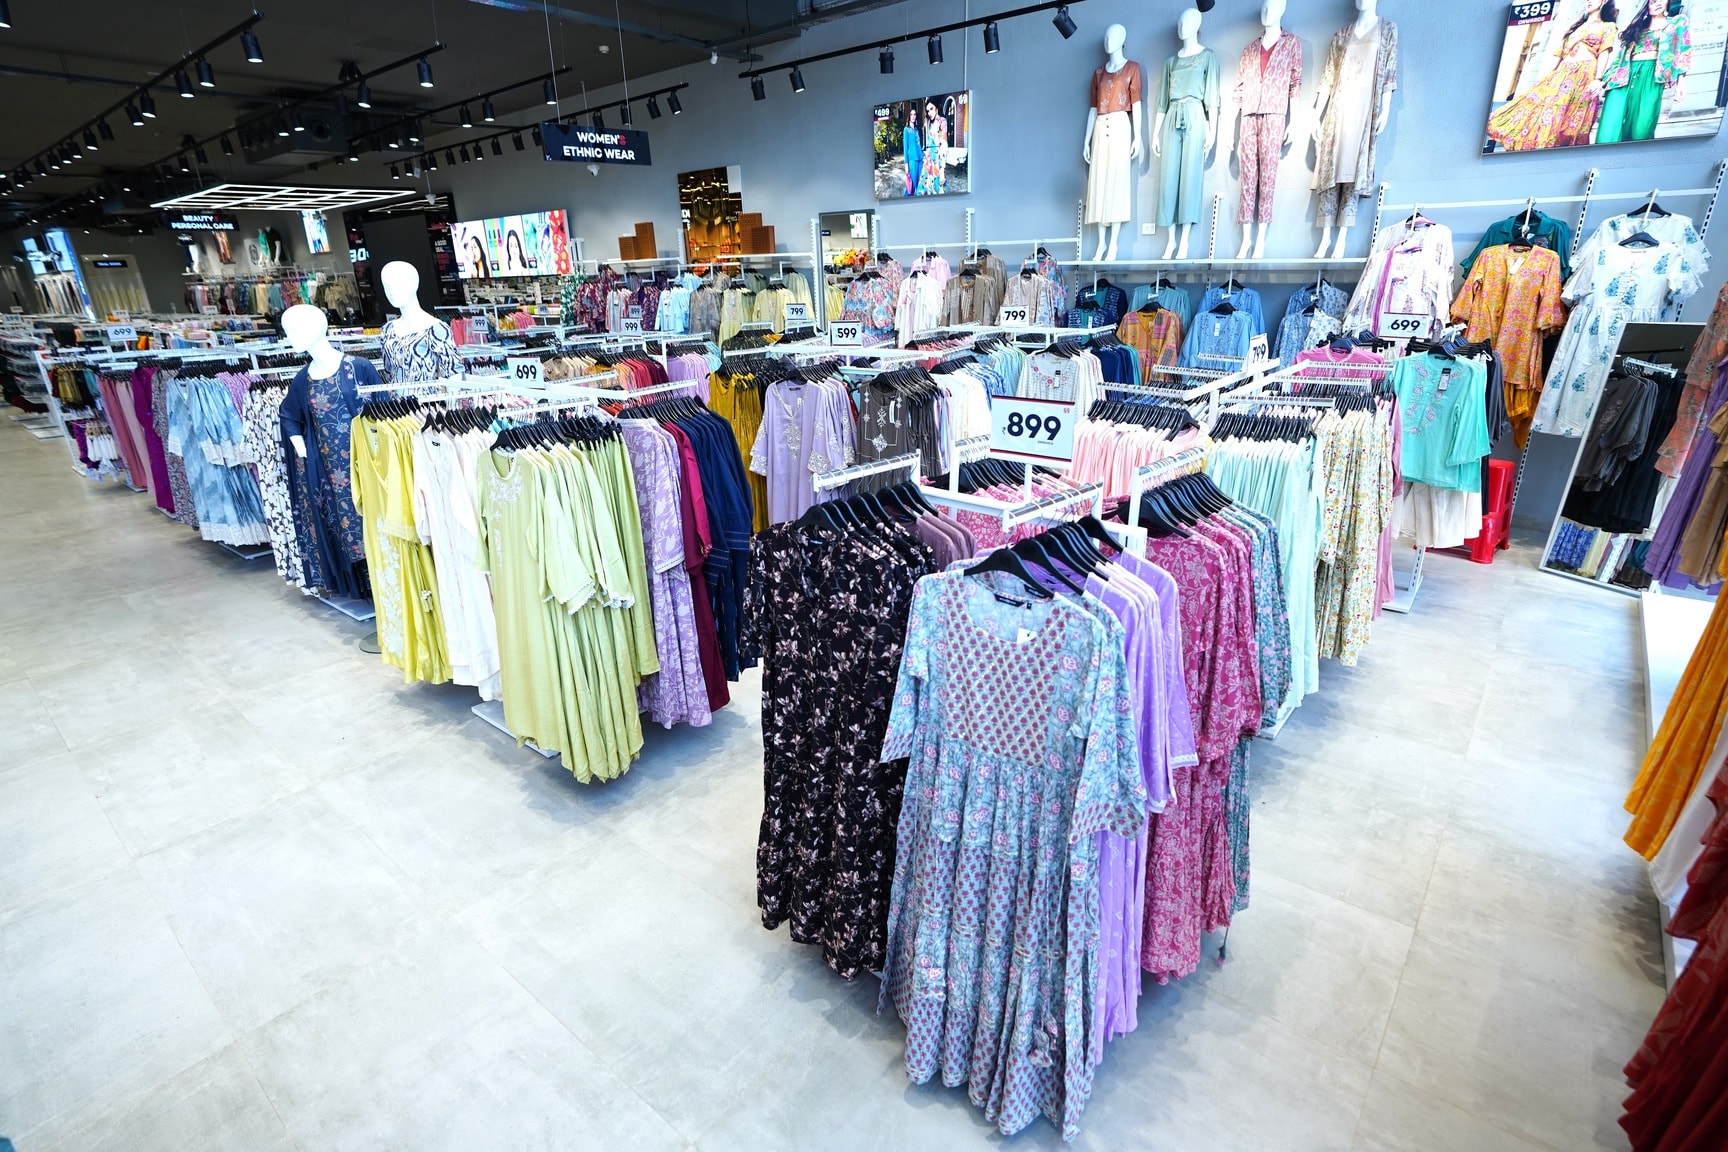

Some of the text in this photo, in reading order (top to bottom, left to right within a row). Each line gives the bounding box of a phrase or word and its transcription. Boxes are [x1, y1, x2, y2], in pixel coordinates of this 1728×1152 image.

[576, 131, 627, 146] WOMEN'S
[562, 145, 636, 160] ETHNIC WEAR
[182, 214, 214, 222] BEAUTY
[171, 222, 234, 230] PERSONAL CARE
[790, 307, 804, 316] 799
[1004, 310, 1026, 321] 799
[624, 321, 638, 332] 999
[1390, 319, 1421, 331] 699
[837, 327, 858, 339] 599
[516, 364, 537, 380] 699
